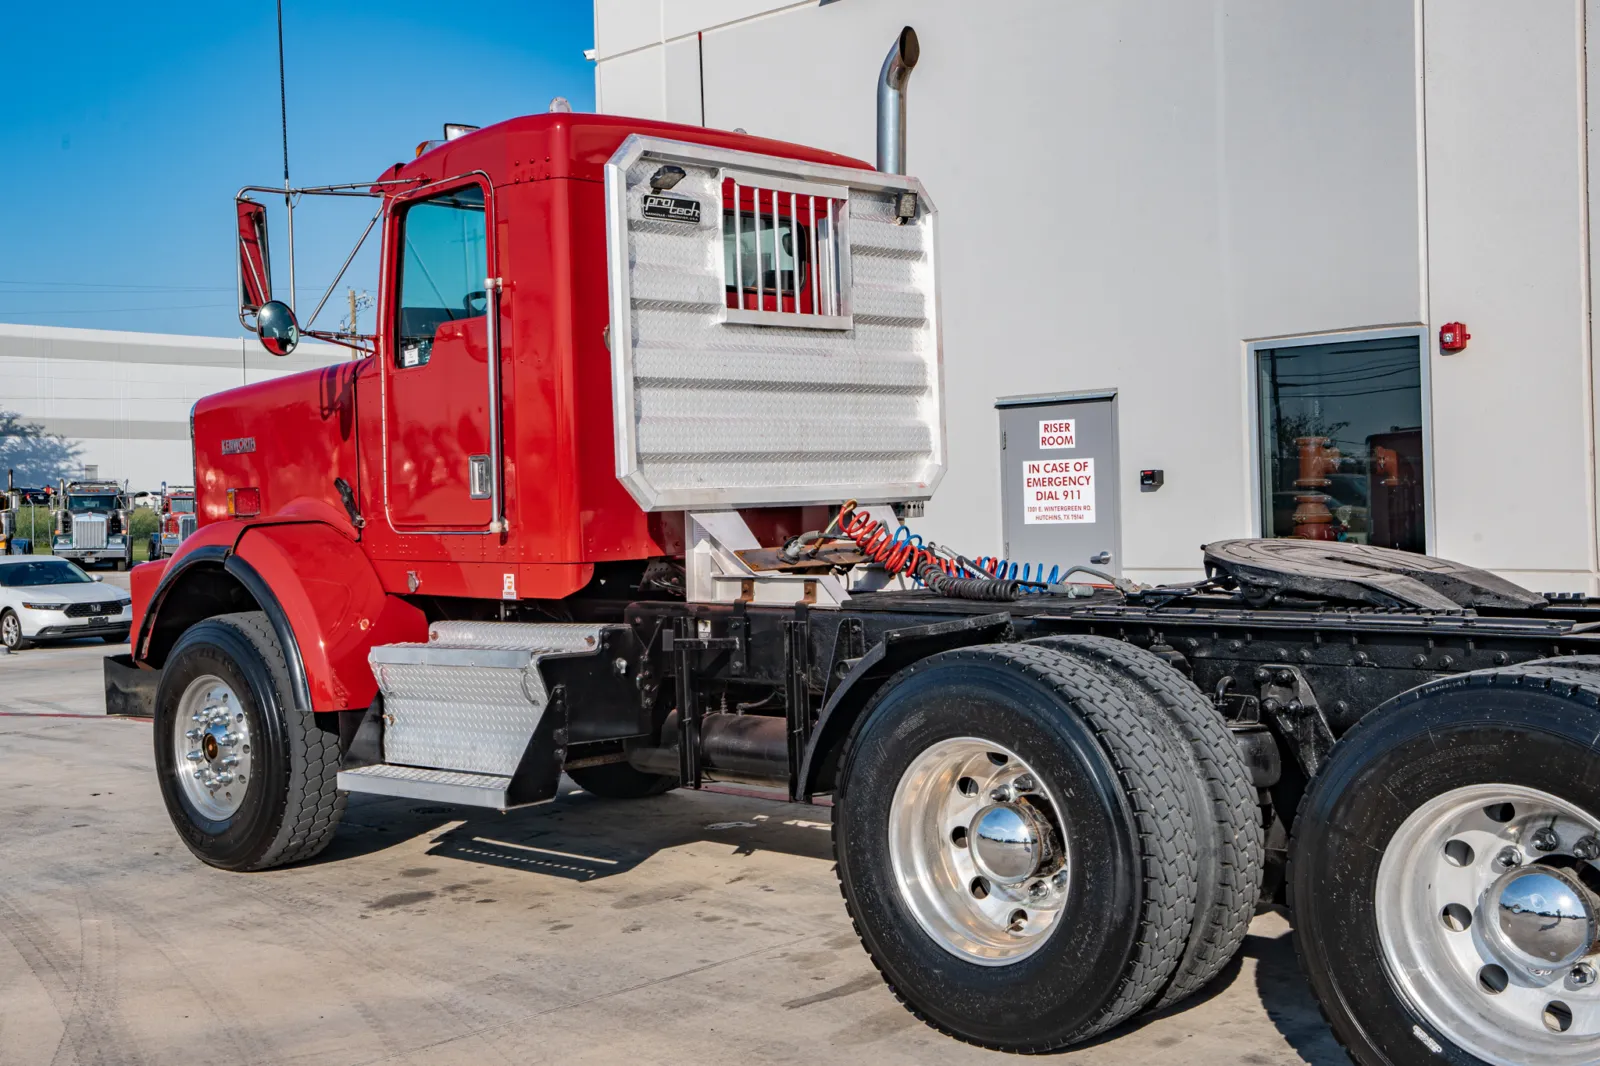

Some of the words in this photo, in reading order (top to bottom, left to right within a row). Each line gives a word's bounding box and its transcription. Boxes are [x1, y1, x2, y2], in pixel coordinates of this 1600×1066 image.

[1043, 423, 1070, 433] RISER
[1041, 436, 1073, 446] ROOM
[1028, 464, 1040, 474] IN
[1043, 462, 1070, 473] CASE
[1073, 462, 1089, 472] OF
[1027, 476, 1091, 487] EMERGENCY
[1036, 491, 1059, 501] DIAL
[1063, 490, 1080, 500] 911
